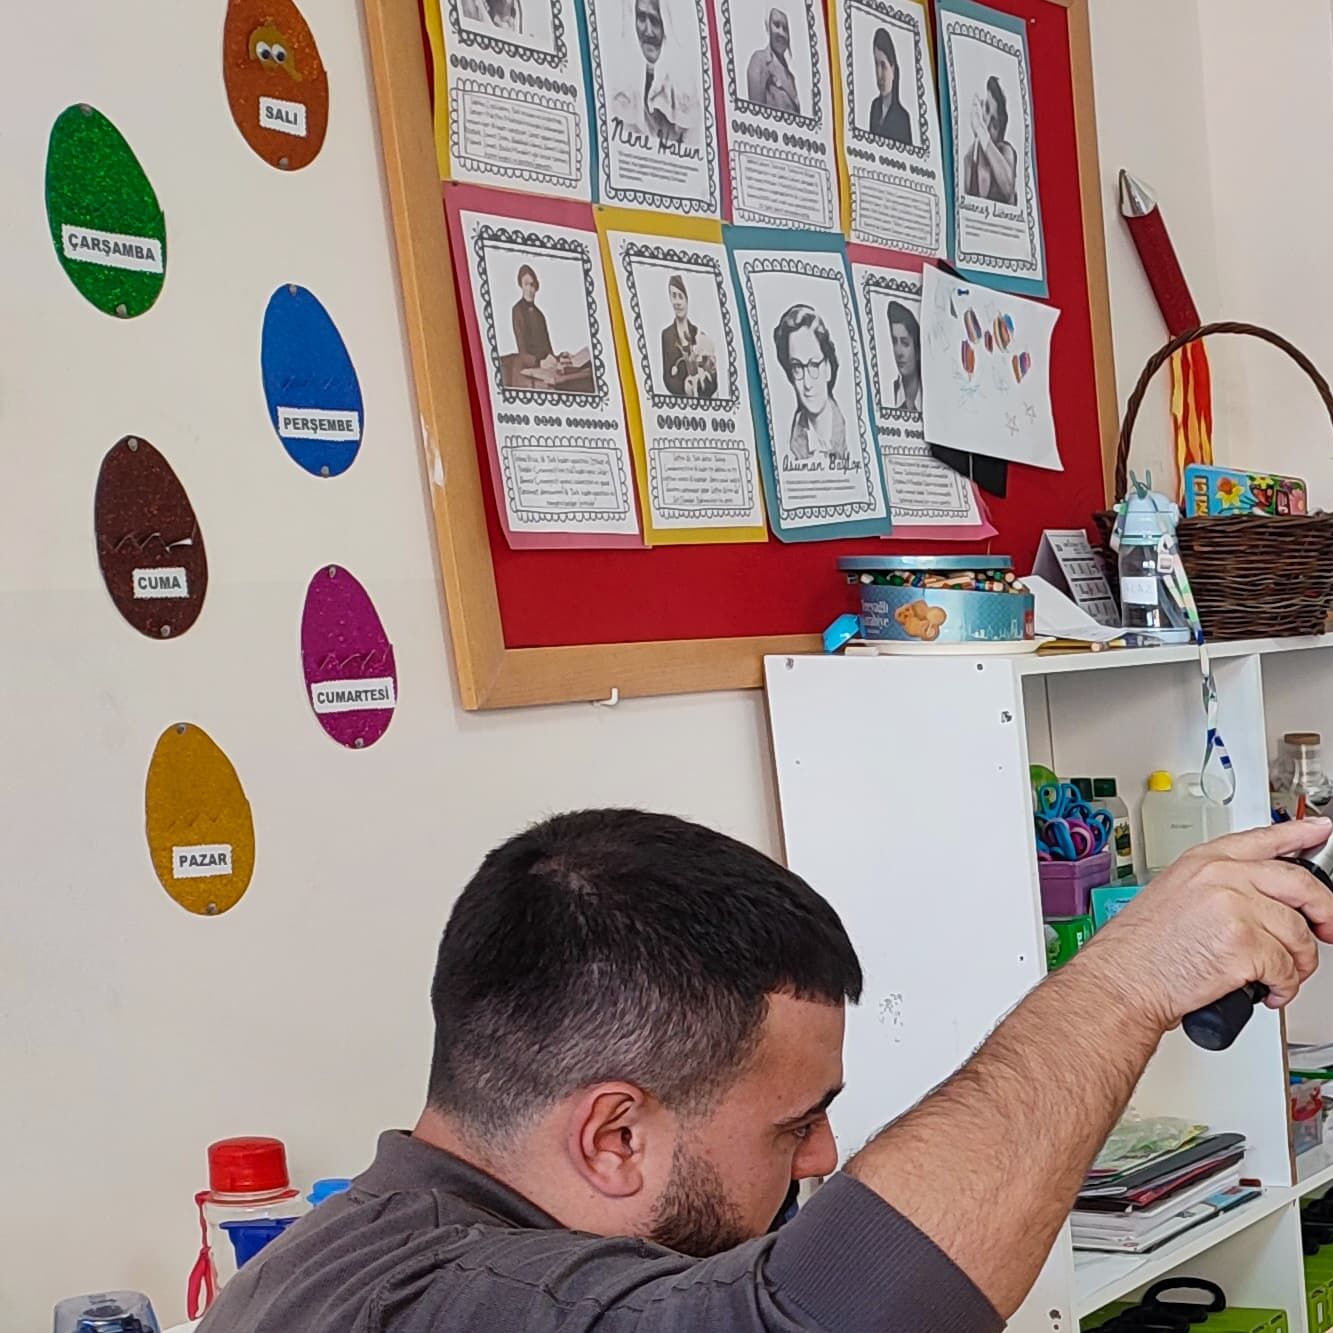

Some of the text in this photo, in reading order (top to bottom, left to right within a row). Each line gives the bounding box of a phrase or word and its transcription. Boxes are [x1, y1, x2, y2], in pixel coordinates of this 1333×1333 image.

[265, 105, 299, 126] SALI
[68, 234, 156, 262] ÇARŞAMBA
[283, 417, 354, 435] PERŞEMBE
[137, 574, 182, 590] CUMA
[316, 686, 390, 705] CUMARTESİ
[178, 851, 228, 869] PAZAR
